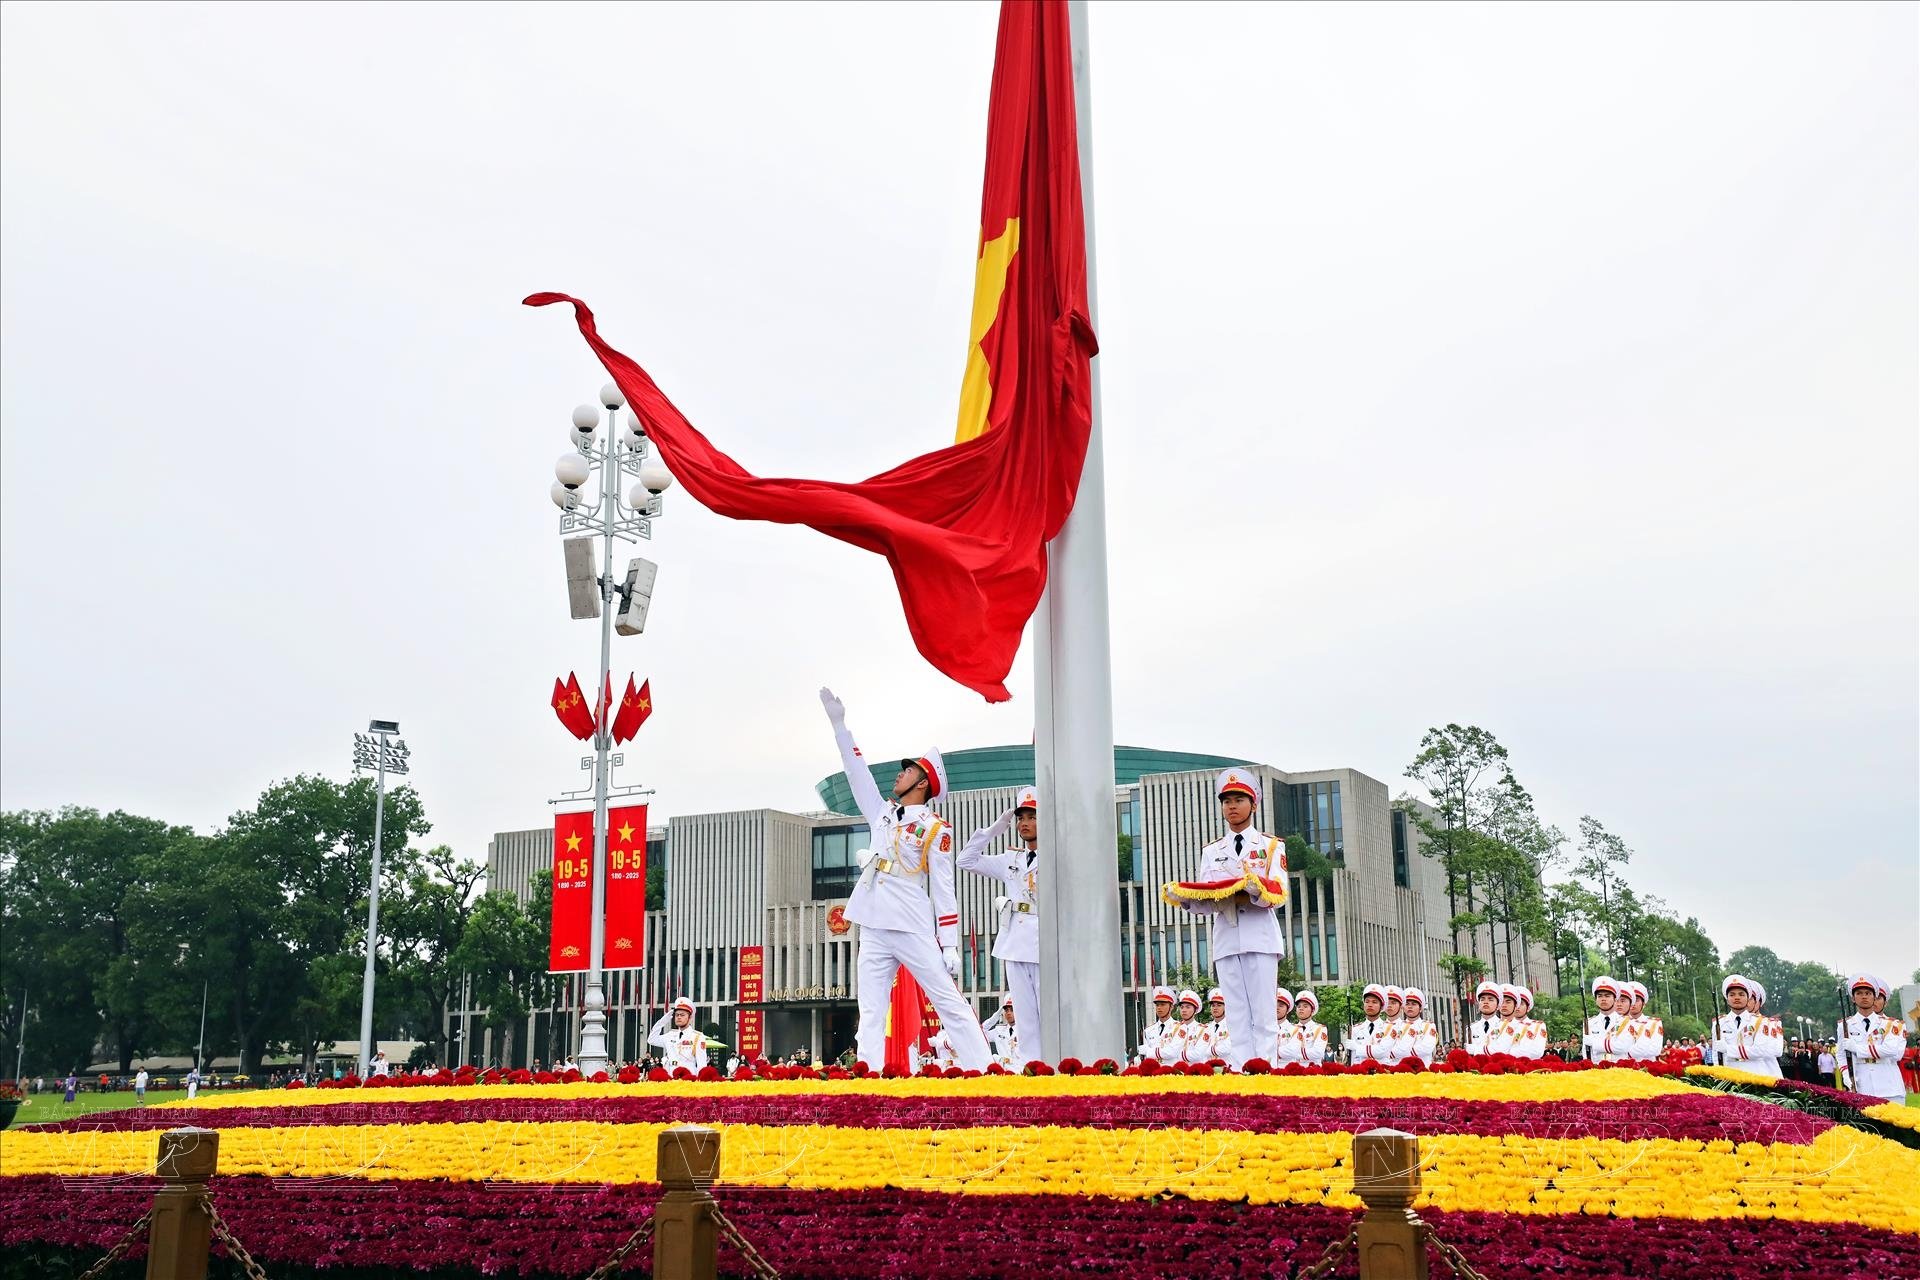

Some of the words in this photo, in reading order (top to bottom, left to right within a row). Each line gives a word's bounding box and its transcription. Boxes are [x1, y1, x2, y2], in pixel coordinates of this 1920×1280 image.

[611, 849, 641, 870] 19-5
[558, 858, 589, 880] 19-5
[625, 872, 640, 880] 2025
[768, 986, 790, 999] NHÀ
[794, 983, 824, 998] QUỐC
[828, 984, 847, 999] HỘI
